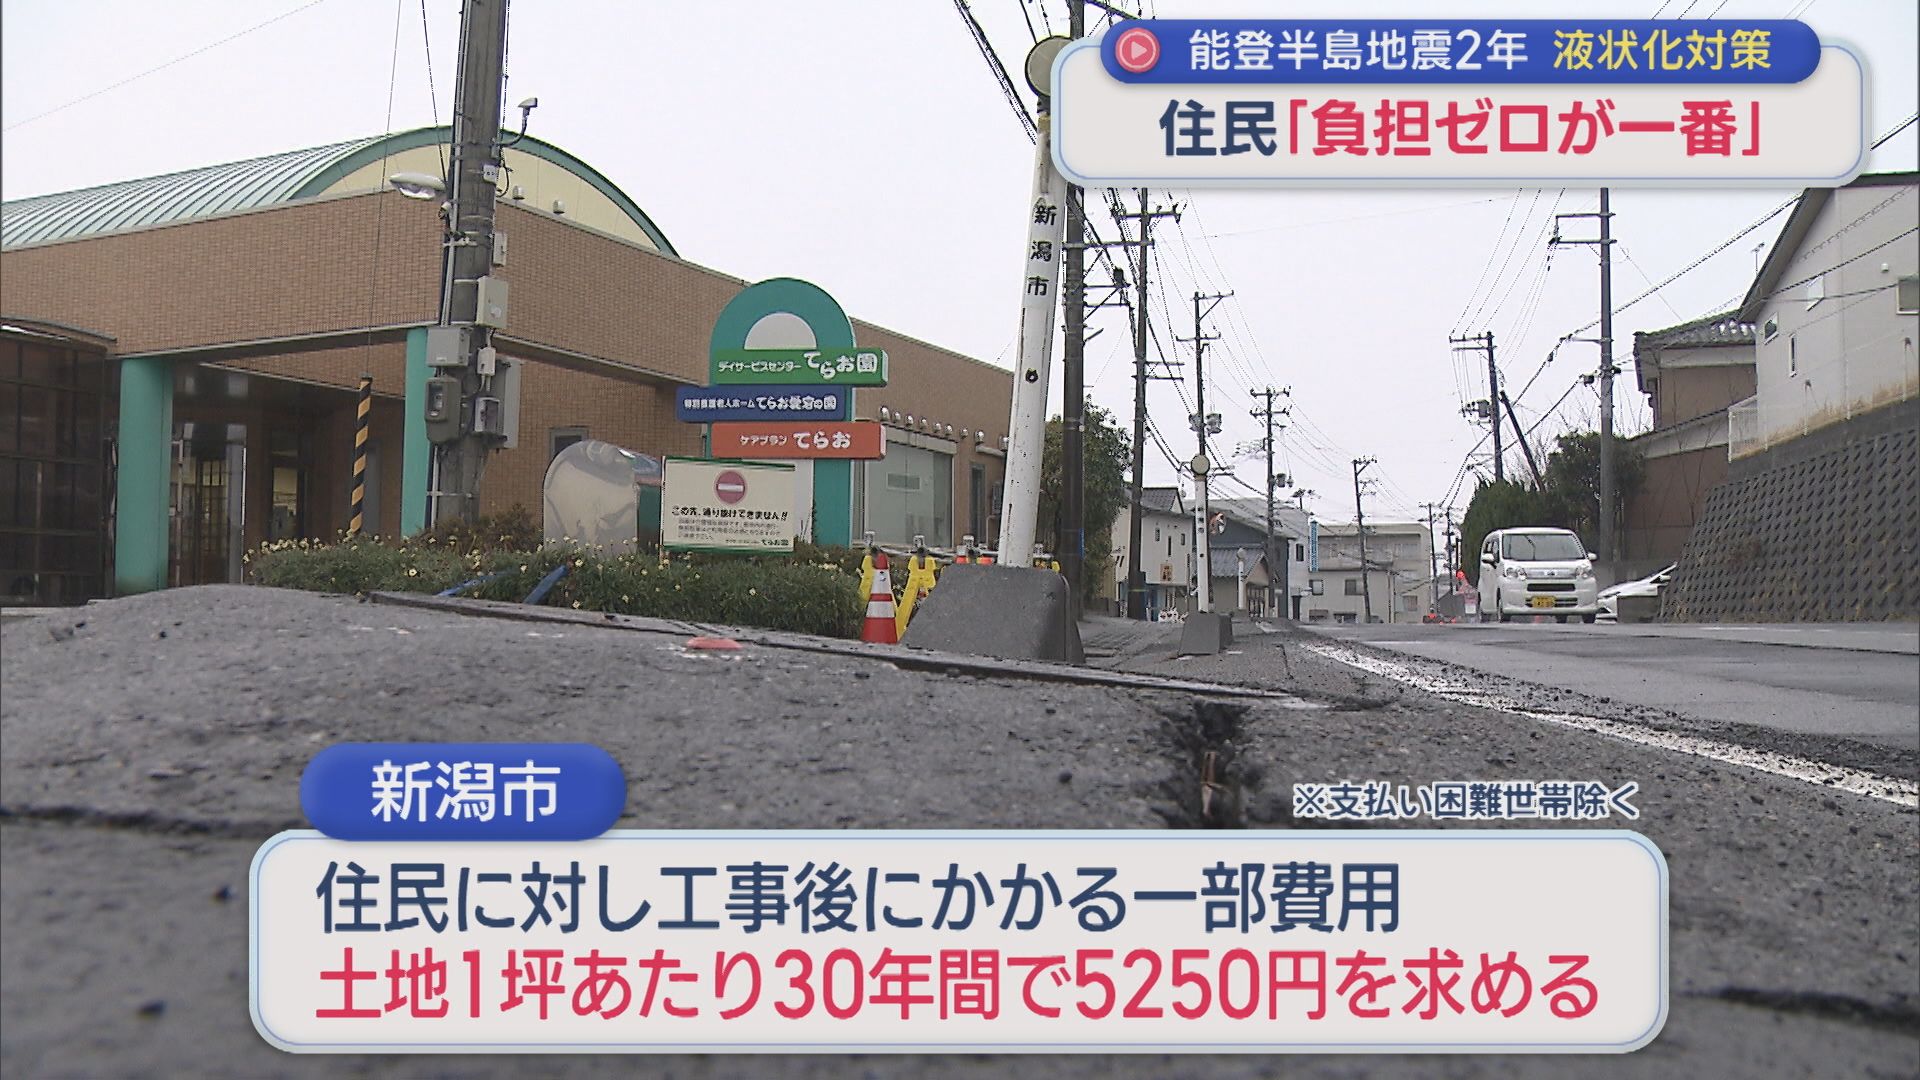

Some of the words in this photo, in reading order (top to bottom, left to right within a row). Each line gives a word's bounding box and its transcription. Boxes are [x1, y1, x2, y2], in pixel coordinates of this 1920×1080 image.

[1027, 200, 1058, 296] 新潟市
[718, 360, 802, 373] デイサービスセンター
[803, 351, 878, 380] てらお園
[740, 434, 788, 447] ケアプラン
[793, 430, 852, 449] てらお
